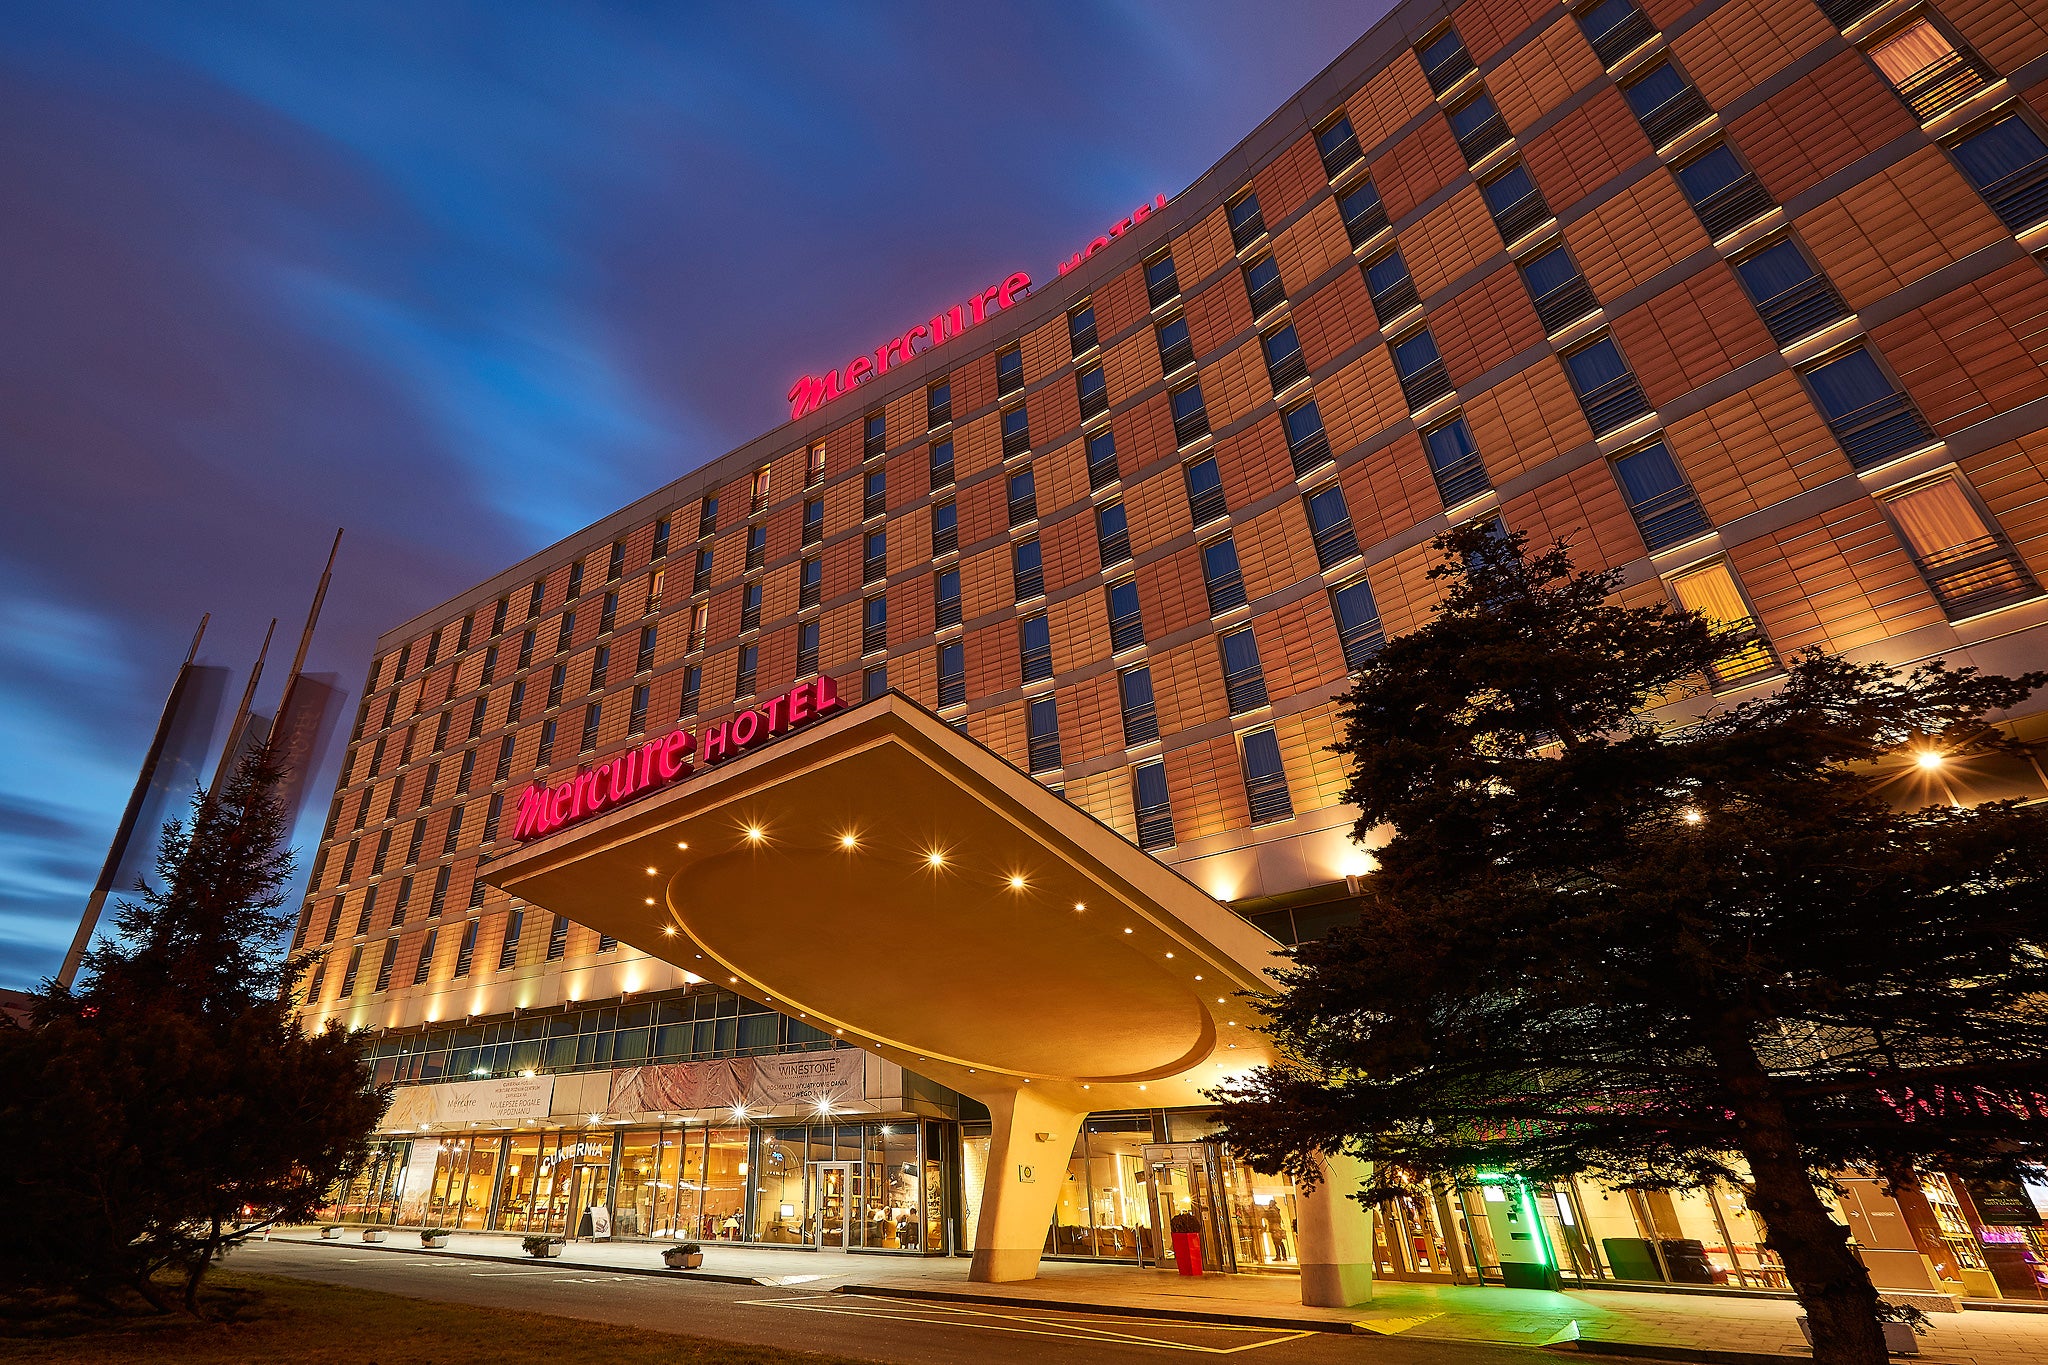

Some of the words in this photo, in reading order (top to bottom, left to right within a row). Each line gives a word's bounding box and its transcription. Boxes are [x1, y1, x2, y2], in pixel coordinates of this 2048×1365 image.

[702, 674, 846, 766] HOTEL
[778, 1062, 836, 1076] WINESTONE
[543, 1142, 603, 1168] CUKIERNIA
